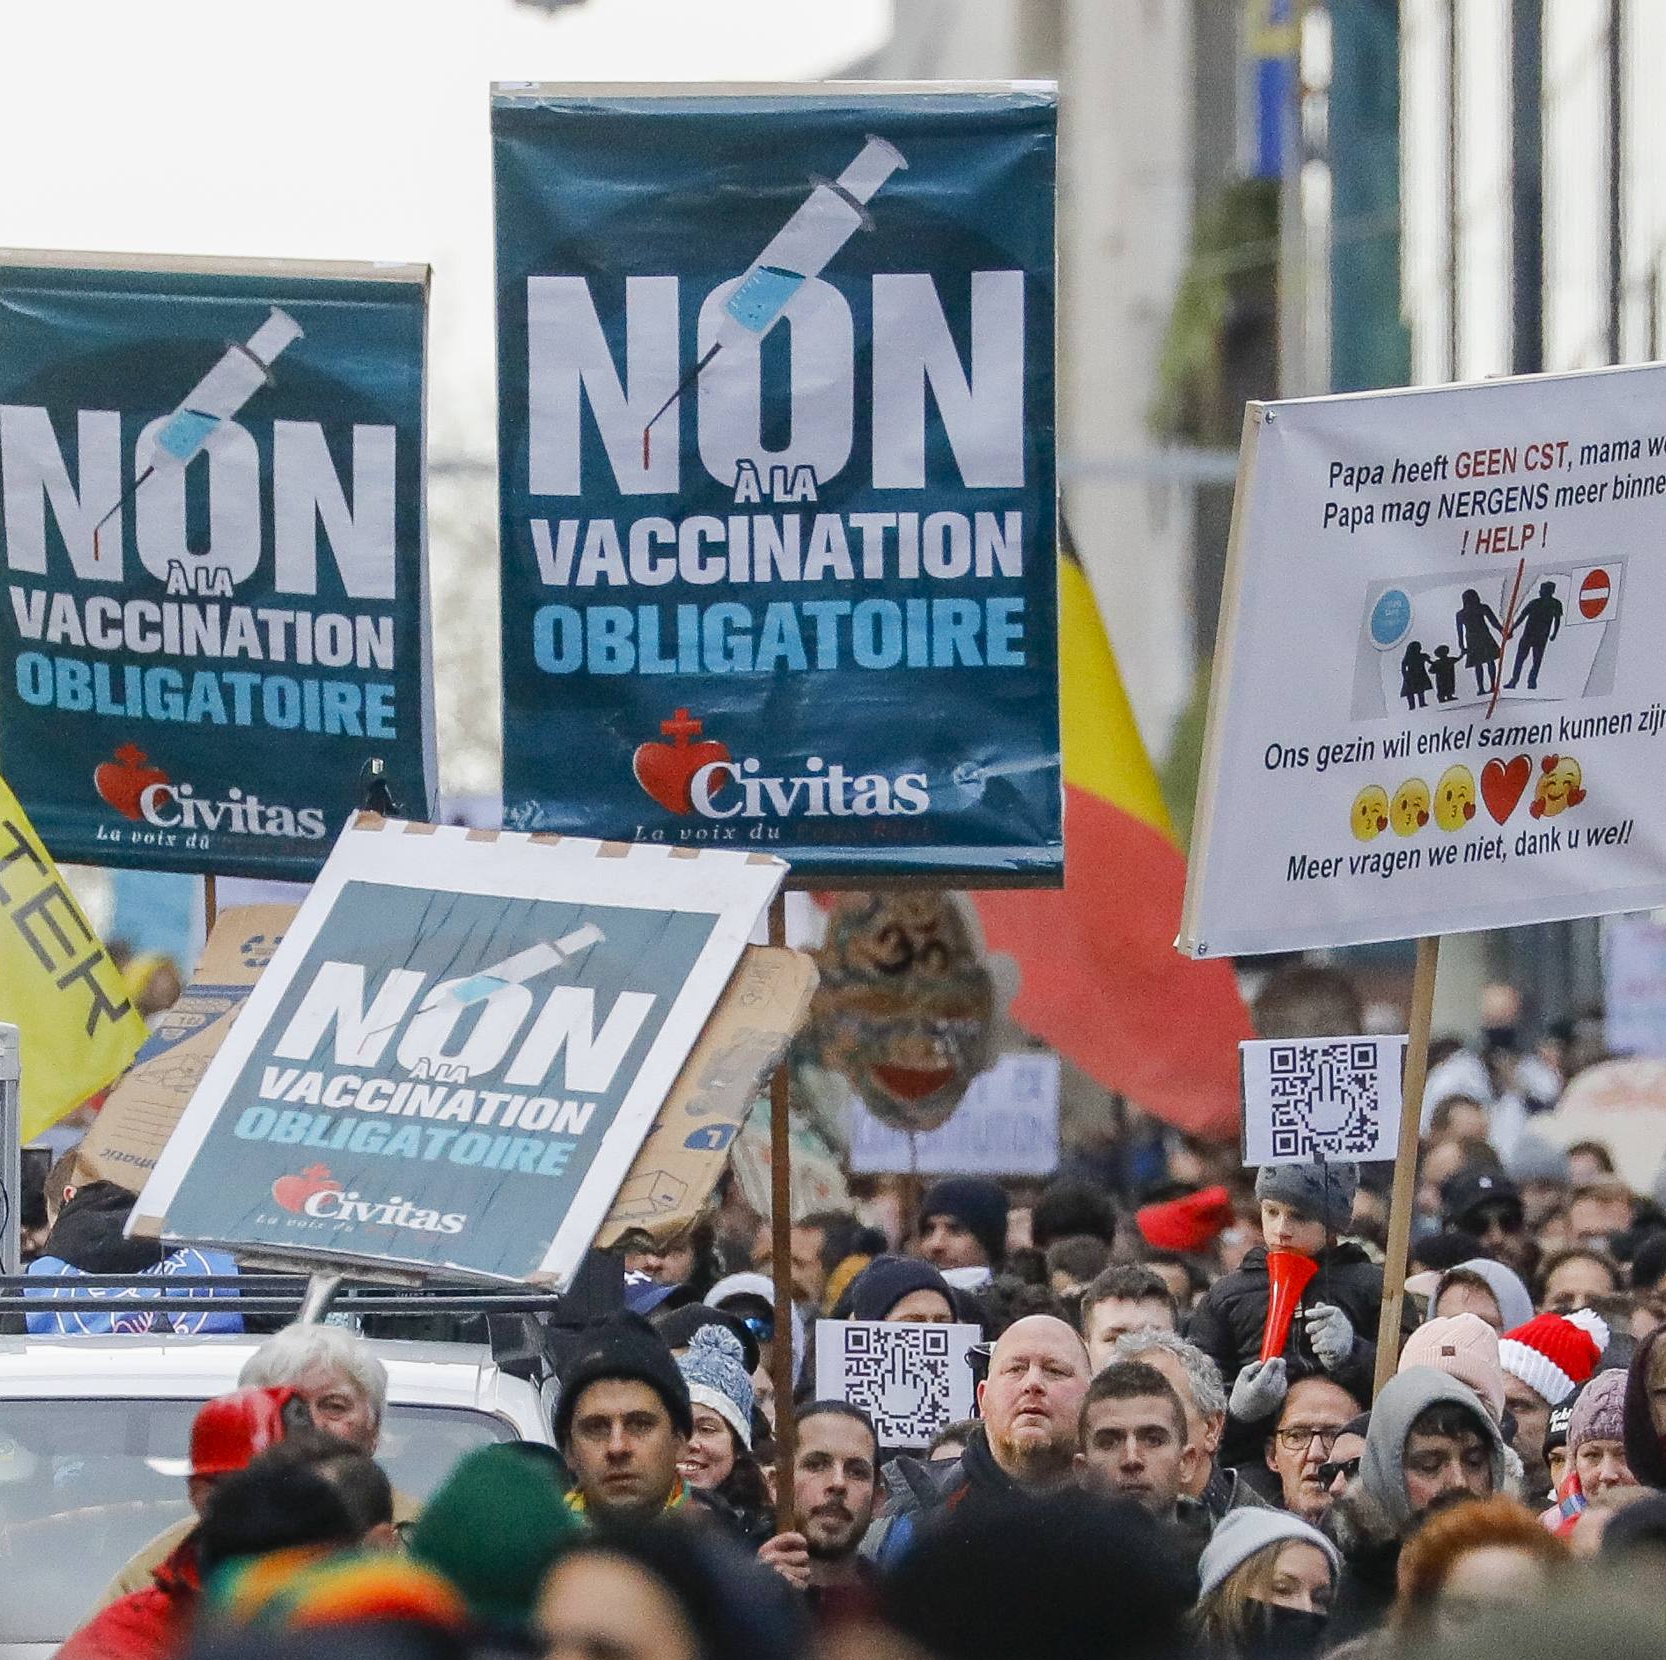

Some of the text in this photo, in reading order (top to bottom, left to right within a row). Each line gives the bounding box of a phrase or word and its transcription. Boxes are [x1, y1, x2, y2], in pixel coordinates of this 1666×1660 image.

[527, 270, 1025, 496] NON
[734, 458, 819, 503] À LA
[1329, 459, 1383, 493] Papa
[1391, 456, 1448, 485] heeft
[1455, 447, 1517, 480] GEEN
[1524, 441, 1573, 476] CST,
[1580, 438, 1640, 467] mama
[0, 404, 396, 600] NON
[1323, 500, 1374, 533] Papa
[1381, 499, 1430, 528] mag
[1438, 484, 1548, 519] NERGENS
[1554, 481, 1607, 509] meer
[530, 511, 1023, 587] VACCINATION
[1475, 524, 1536, 554] HELP
[195, 565, 233, 598] LA
[8, 584, 393, 669] VACCINATION
[532, 598, 1026, 676] OBLIGATOIRE
[15, 652, 397, 739] OBLIGATOIRE
[1264, 742, 1309, 771] Ons
[1315, 735, 1375, 770] gezin
[1382, 730, 1411, 758] wil
[1417, 724, 1473, 753] enkel
[1478, 722, 1552, 749] samen
[1559, 710, 1633, 741] kunnen
[140, 782, 327, 840] Civitas
[689, 756, 930, 822] Civitas
[97, 826, 122, 842] La
[131, 829, 176, 848] voix
[634, 826, 664, 840] La
[680, 825, 736, 840] voix
[749, 824, 781, 840] du
[1286, 819, 1634, 883] Meer vragen we niet, dank u wel!
[275, 961, 656, 1093] NON
[259, 1067, 594, 1137] VACCINATION
[439, 1062, 470, 1082] LA
[235, 1107, 576, 1176] OBLIGATOIRE
[304, 1189, 467, 1235] Civitas
